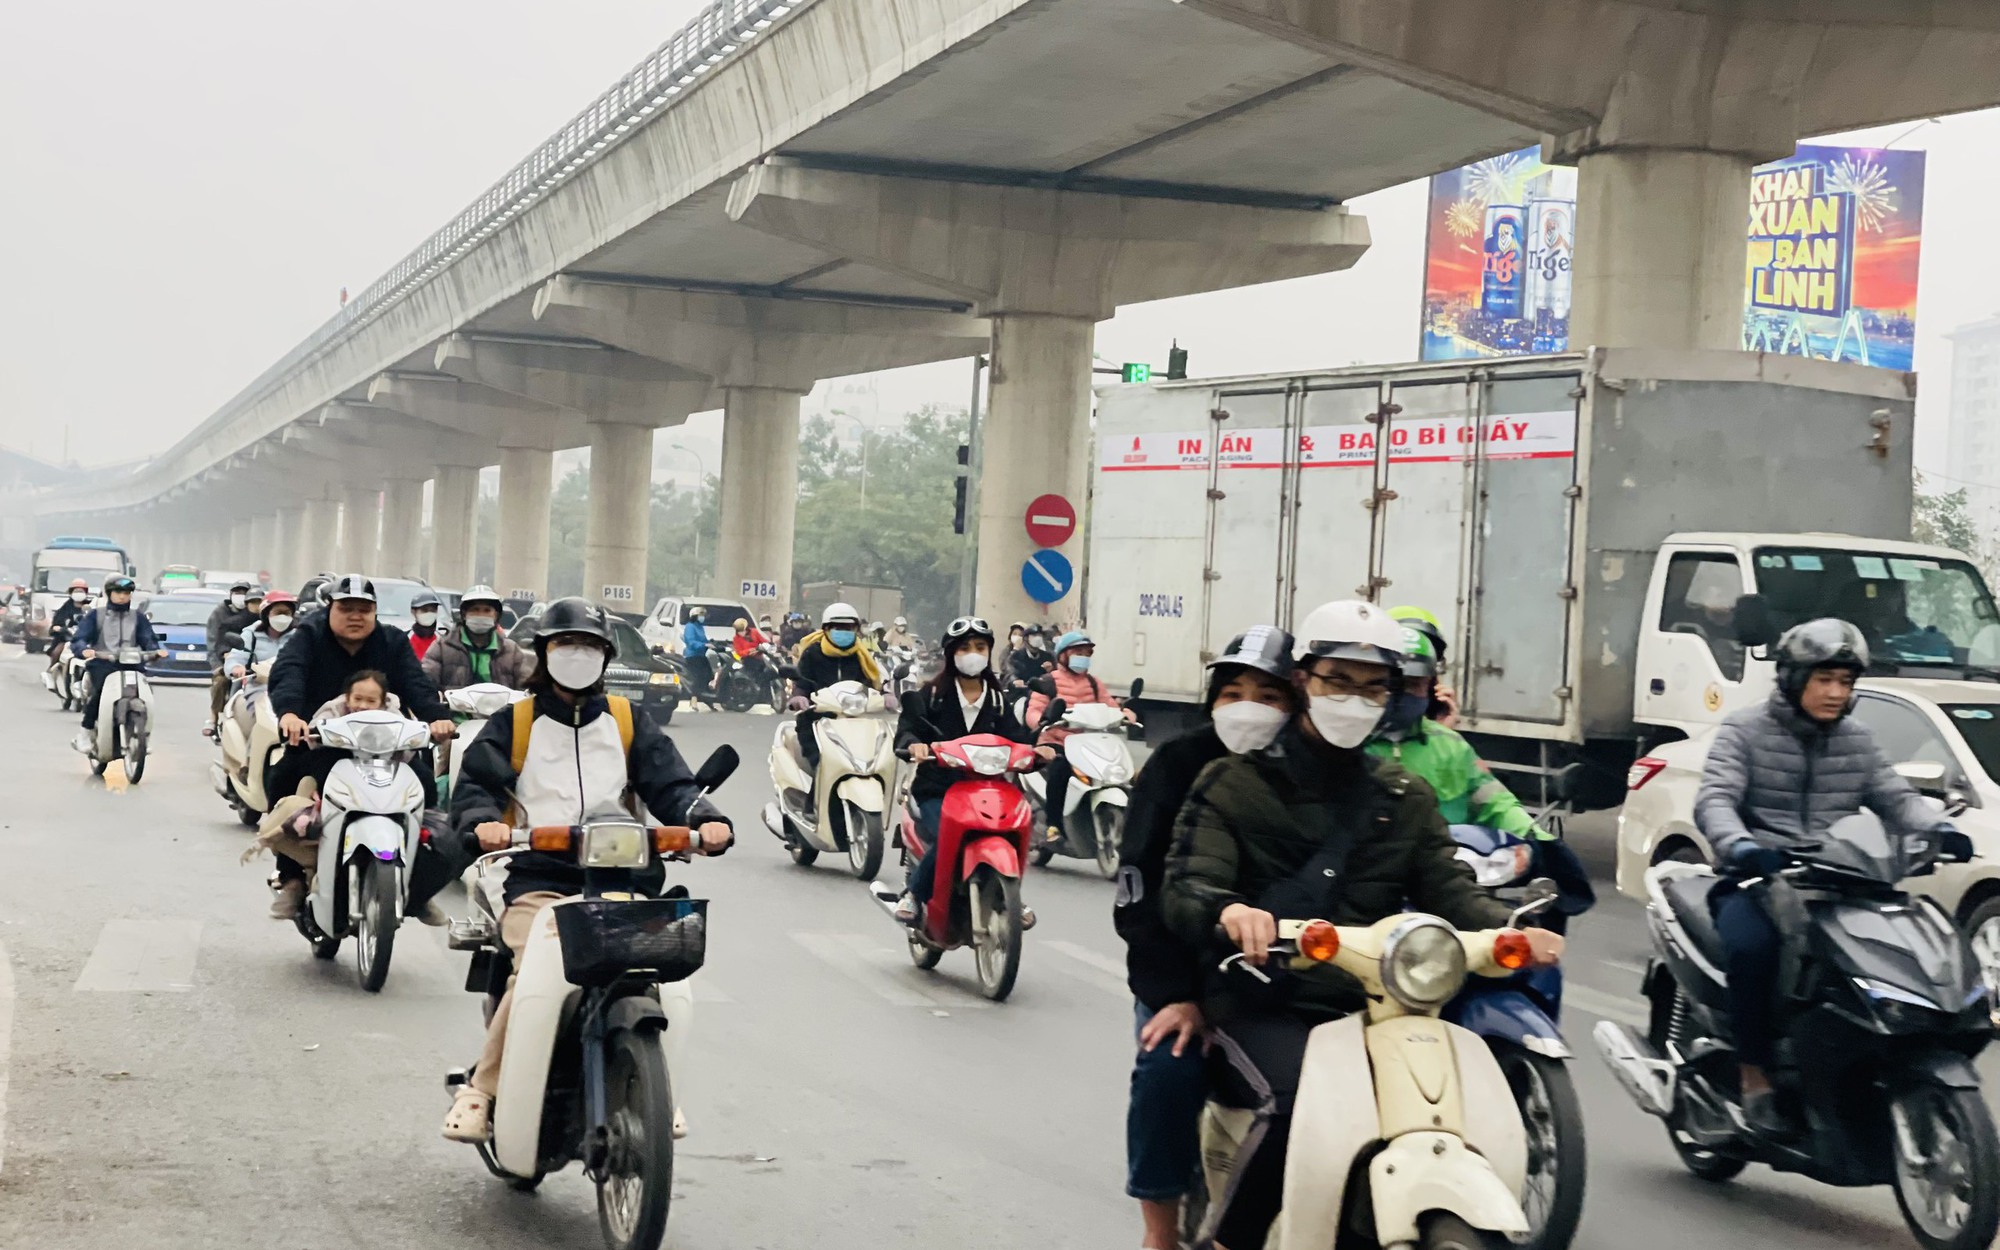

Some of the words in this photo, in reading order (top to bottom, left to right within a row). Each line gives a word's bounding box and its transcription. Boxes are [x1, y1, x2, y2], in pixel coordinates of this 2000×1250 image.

[1751, 168, 1811, 202] KHAI
[1748, 188, 1838, 237] XUÂN
[1178, 438, 1202, 455] IN
[1219, 431, 1252, 452] ẤN
[1300, 435, 1315, 451] &
[1418, 422, 1446, 446] BÌ
[1457, 416, 1530, 444] GIẤY
